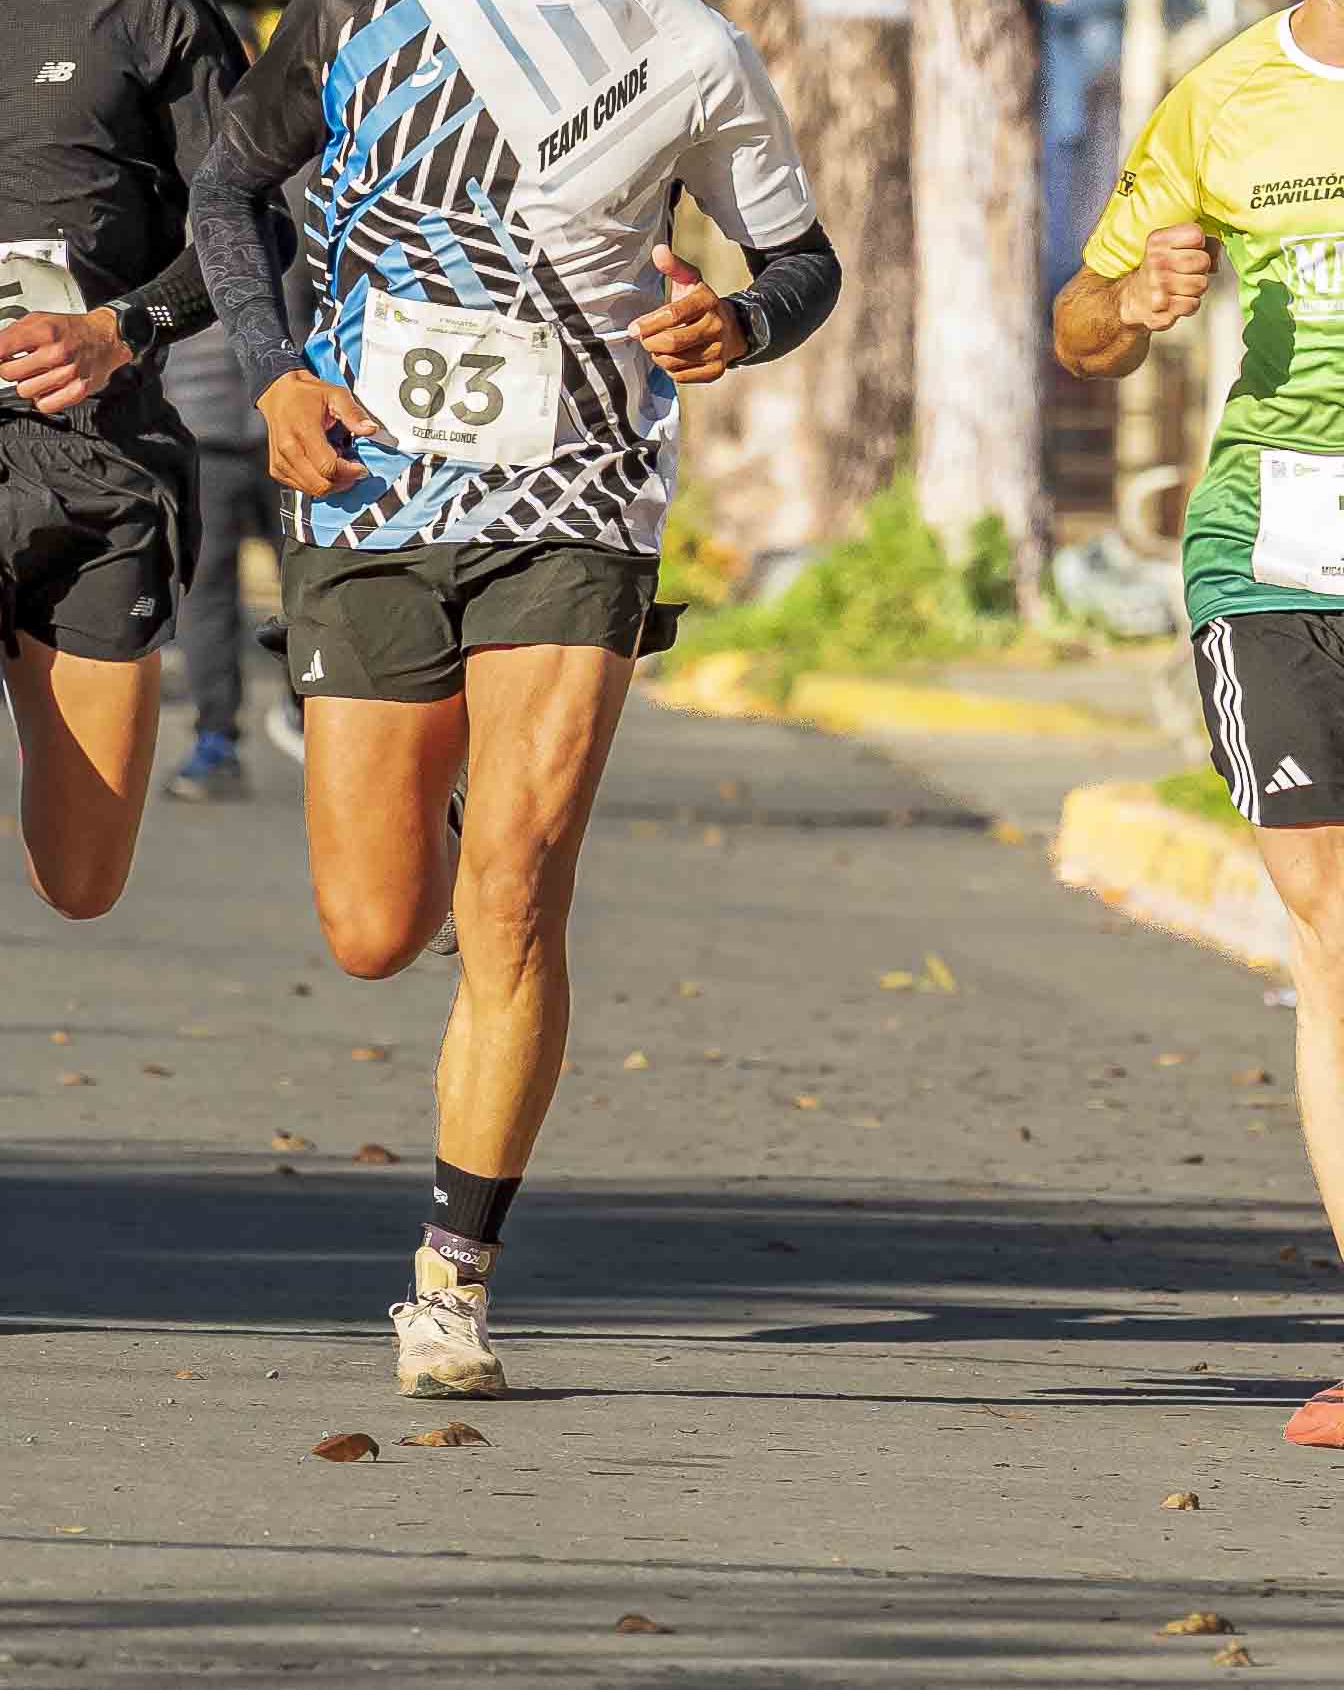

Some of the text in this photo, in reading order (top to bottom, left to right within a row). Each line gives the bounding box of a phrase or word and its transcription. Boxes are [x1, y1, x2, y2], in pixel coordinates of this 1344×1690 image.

[538, 58, 648, 173] TEAM CONDE
[399, 347, 506, 426] 83
[450, 431, 478, 444] CONDE
